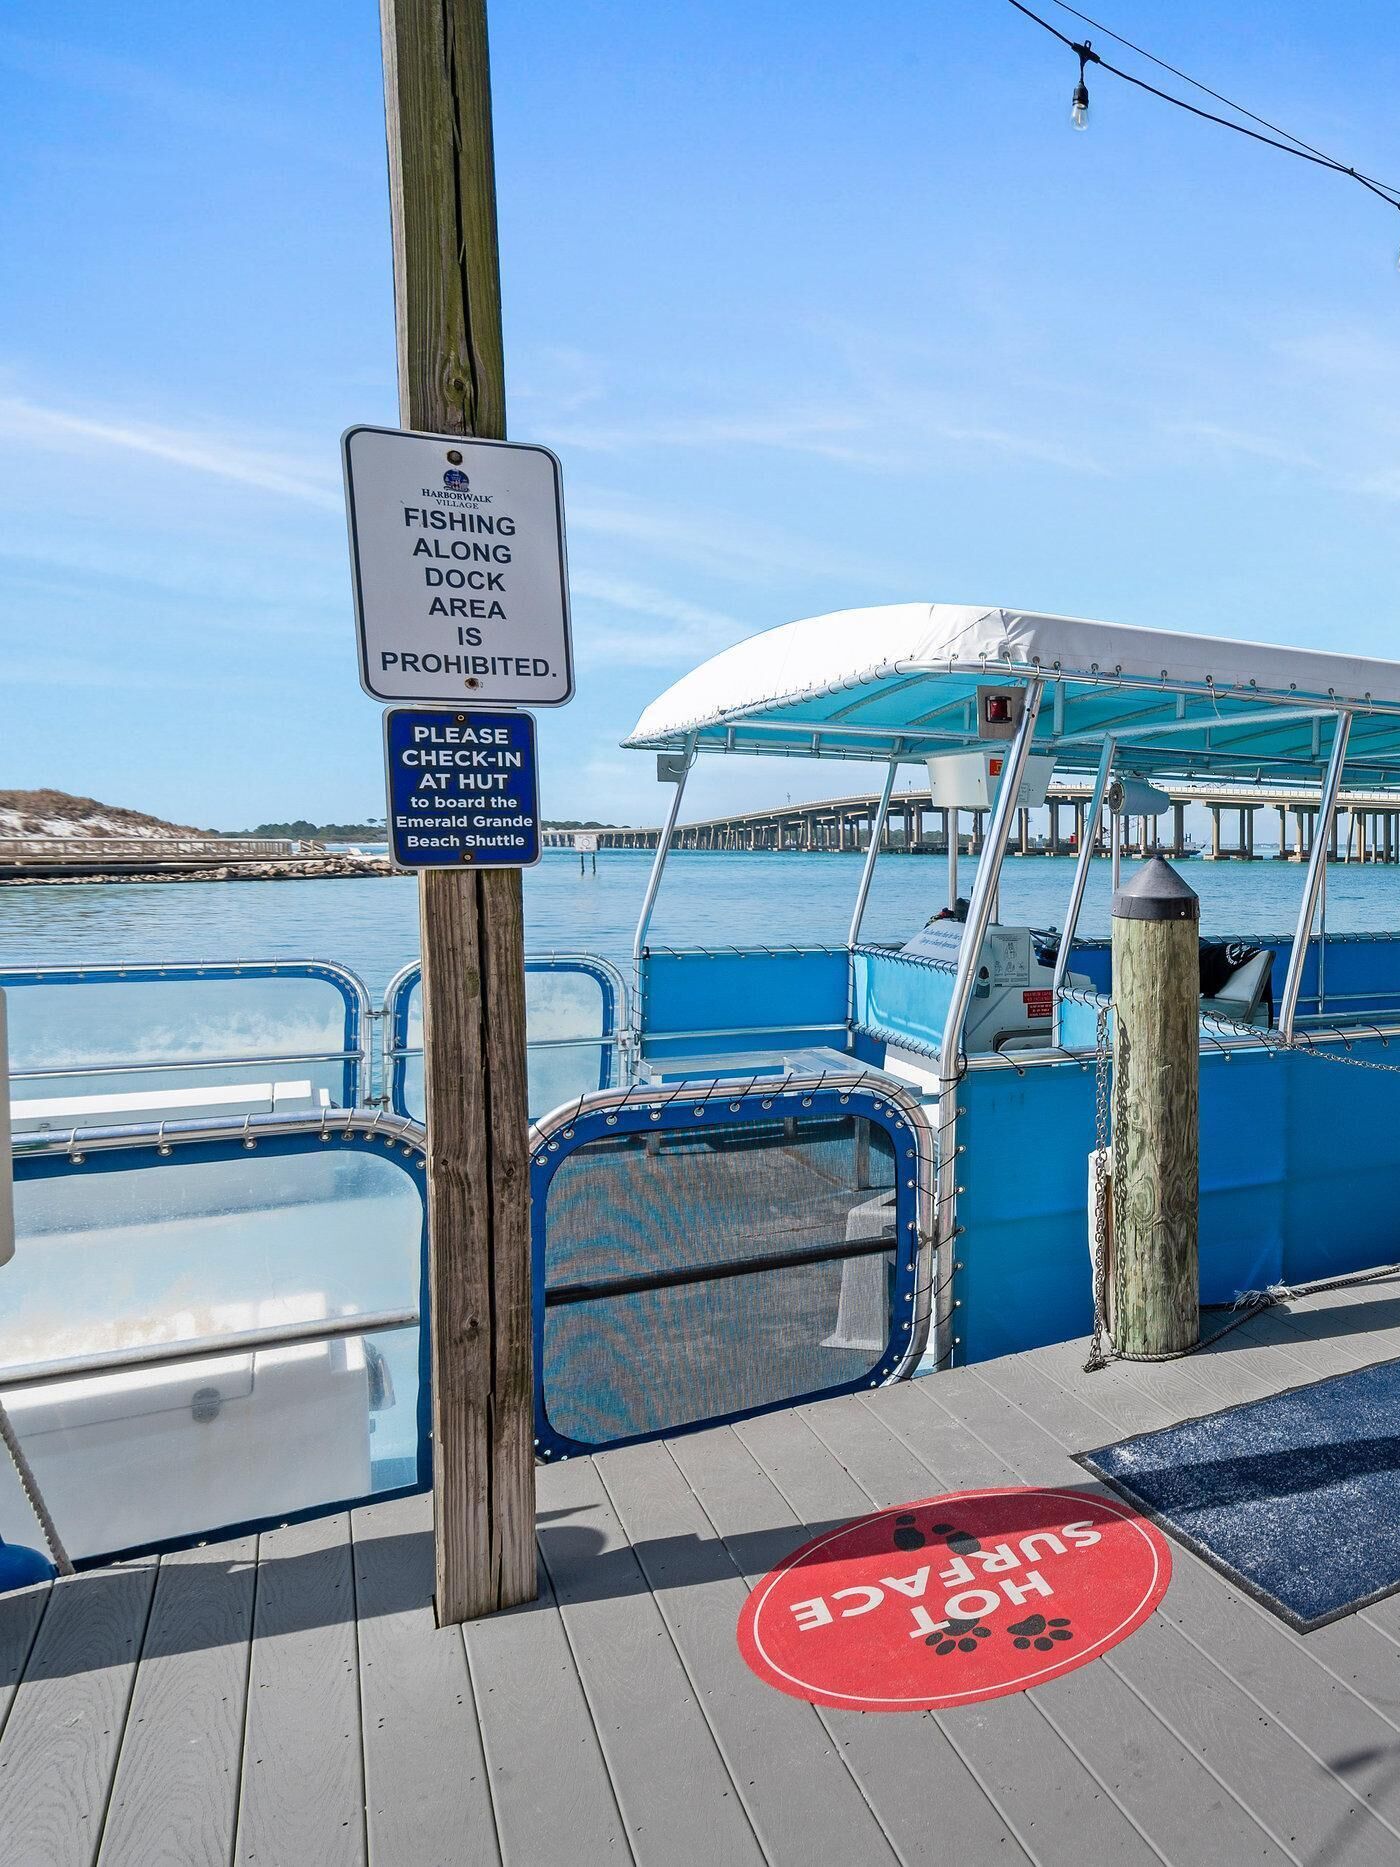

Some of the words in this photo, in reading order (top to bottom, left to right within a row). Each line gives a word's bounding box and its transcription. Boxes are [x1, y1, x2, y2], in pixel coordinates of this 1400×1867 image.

[422, 488, 492, 504] HARBORWALK
[436, 498, 479, 510] VILLAGE
[404, 507, 516, 536] FISHING
[412, 537, 512, 565] ALONG
[425, 567, 506, 592] DOCK
[428, 596, 507, 620] AREA
[457, 626, 483, 647] IS
[380, 651, 557, 678] PROHIBITED.
[414, 726, 509, 744] PLEASE
[402, 750, 522, 767] CHECK-IN
[419, 773, 450, 789] AT
[459, 773, 508, 790] HUT
[411, 797, 429, 808] to
[434, 796, 486, 808] board
[490, 796, 518, 808] the
[396, 816, 468, 828] Emerald
[473, 815, 533, 828] Grande
[407, 835, 460, 848] Beach
[465, 834, 525, 847] Shuttle
[788, 1520, 1103, 1632] SURFACE
[908, 1569, 1055, 1640] HOT
